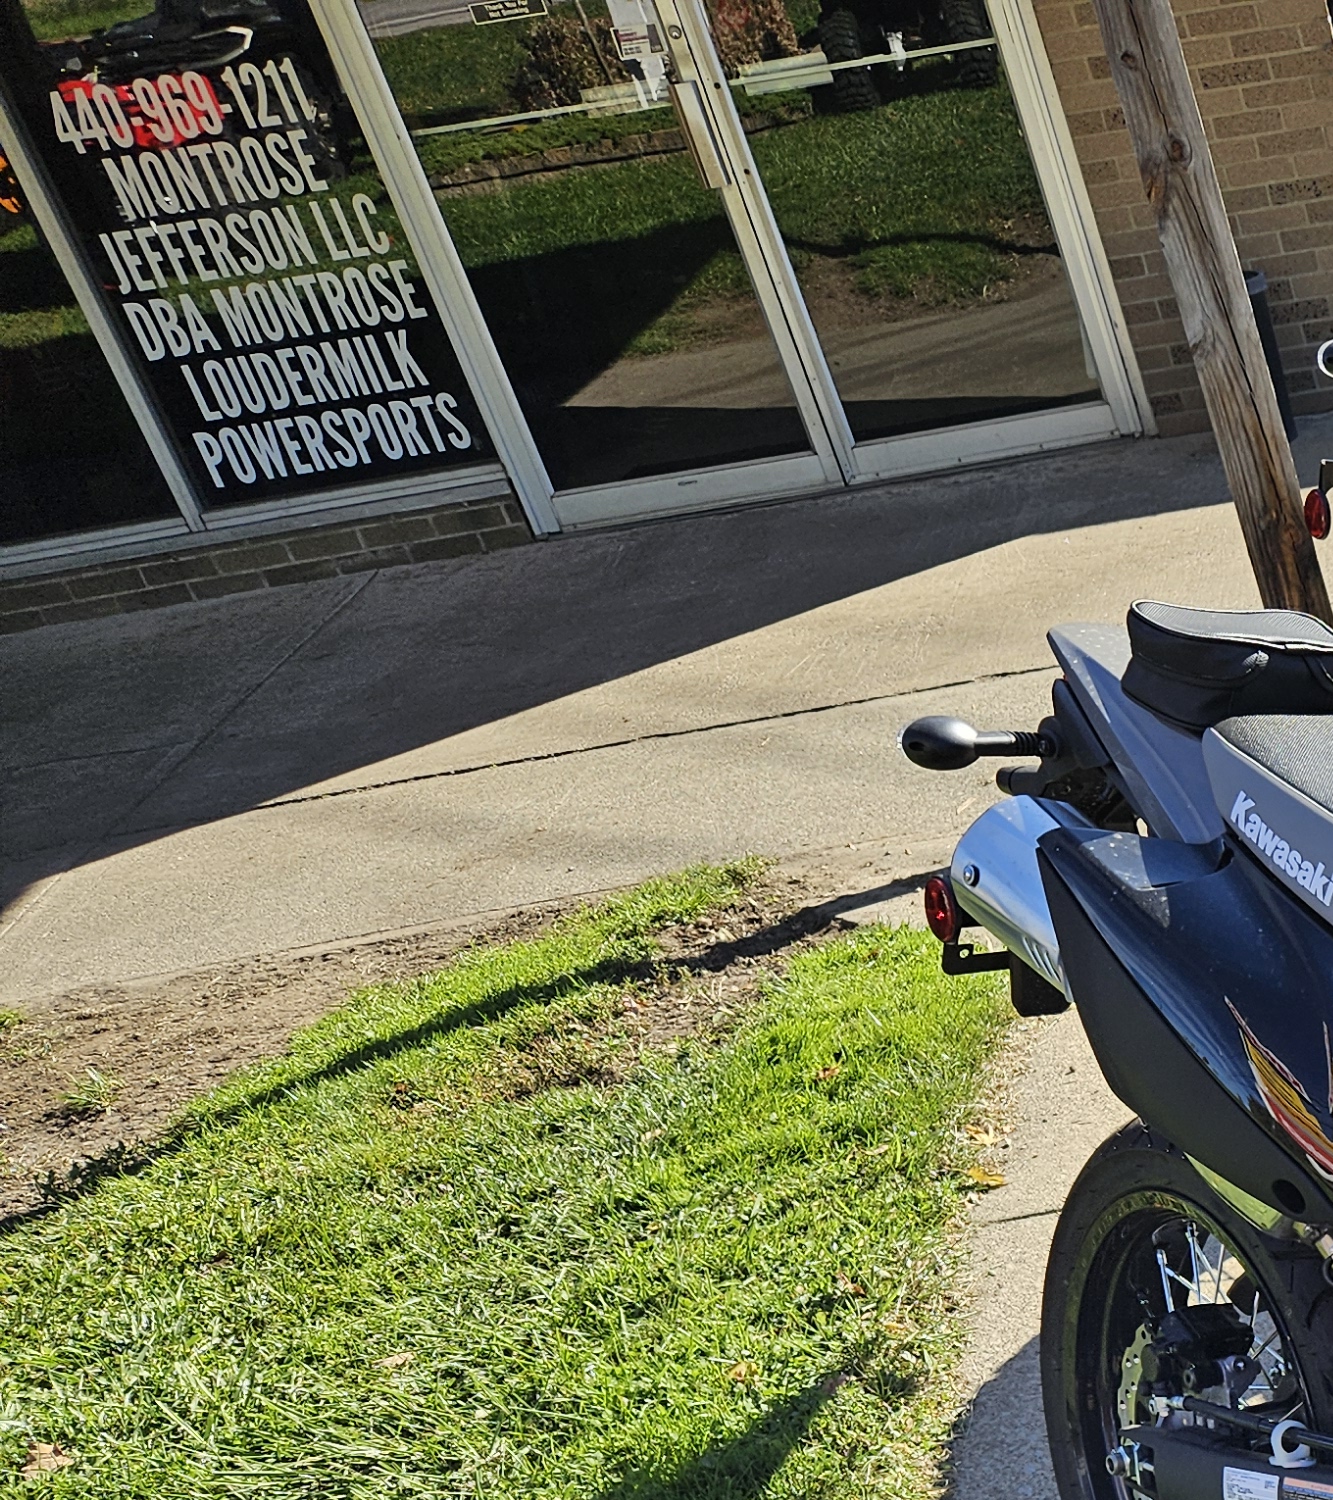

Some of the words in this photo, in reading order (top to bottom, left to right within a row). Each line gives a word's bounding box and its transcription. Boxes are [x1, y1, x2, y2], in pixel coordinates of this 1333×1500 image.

[50, 57, 317, 154] 440-969-1211
[101, 128, 328, 221] MONTROSE
[99, 204, 318, 295] JEFFERSON
[308, 193, 391, 261] LLC
[122, 293, 222, 362] DBA
[210, 259, 428, 348] MONTROSE
[180, 329, 430, 422] LOUDERMILK
[192, 392, 472, 489] POWERSPORTS
